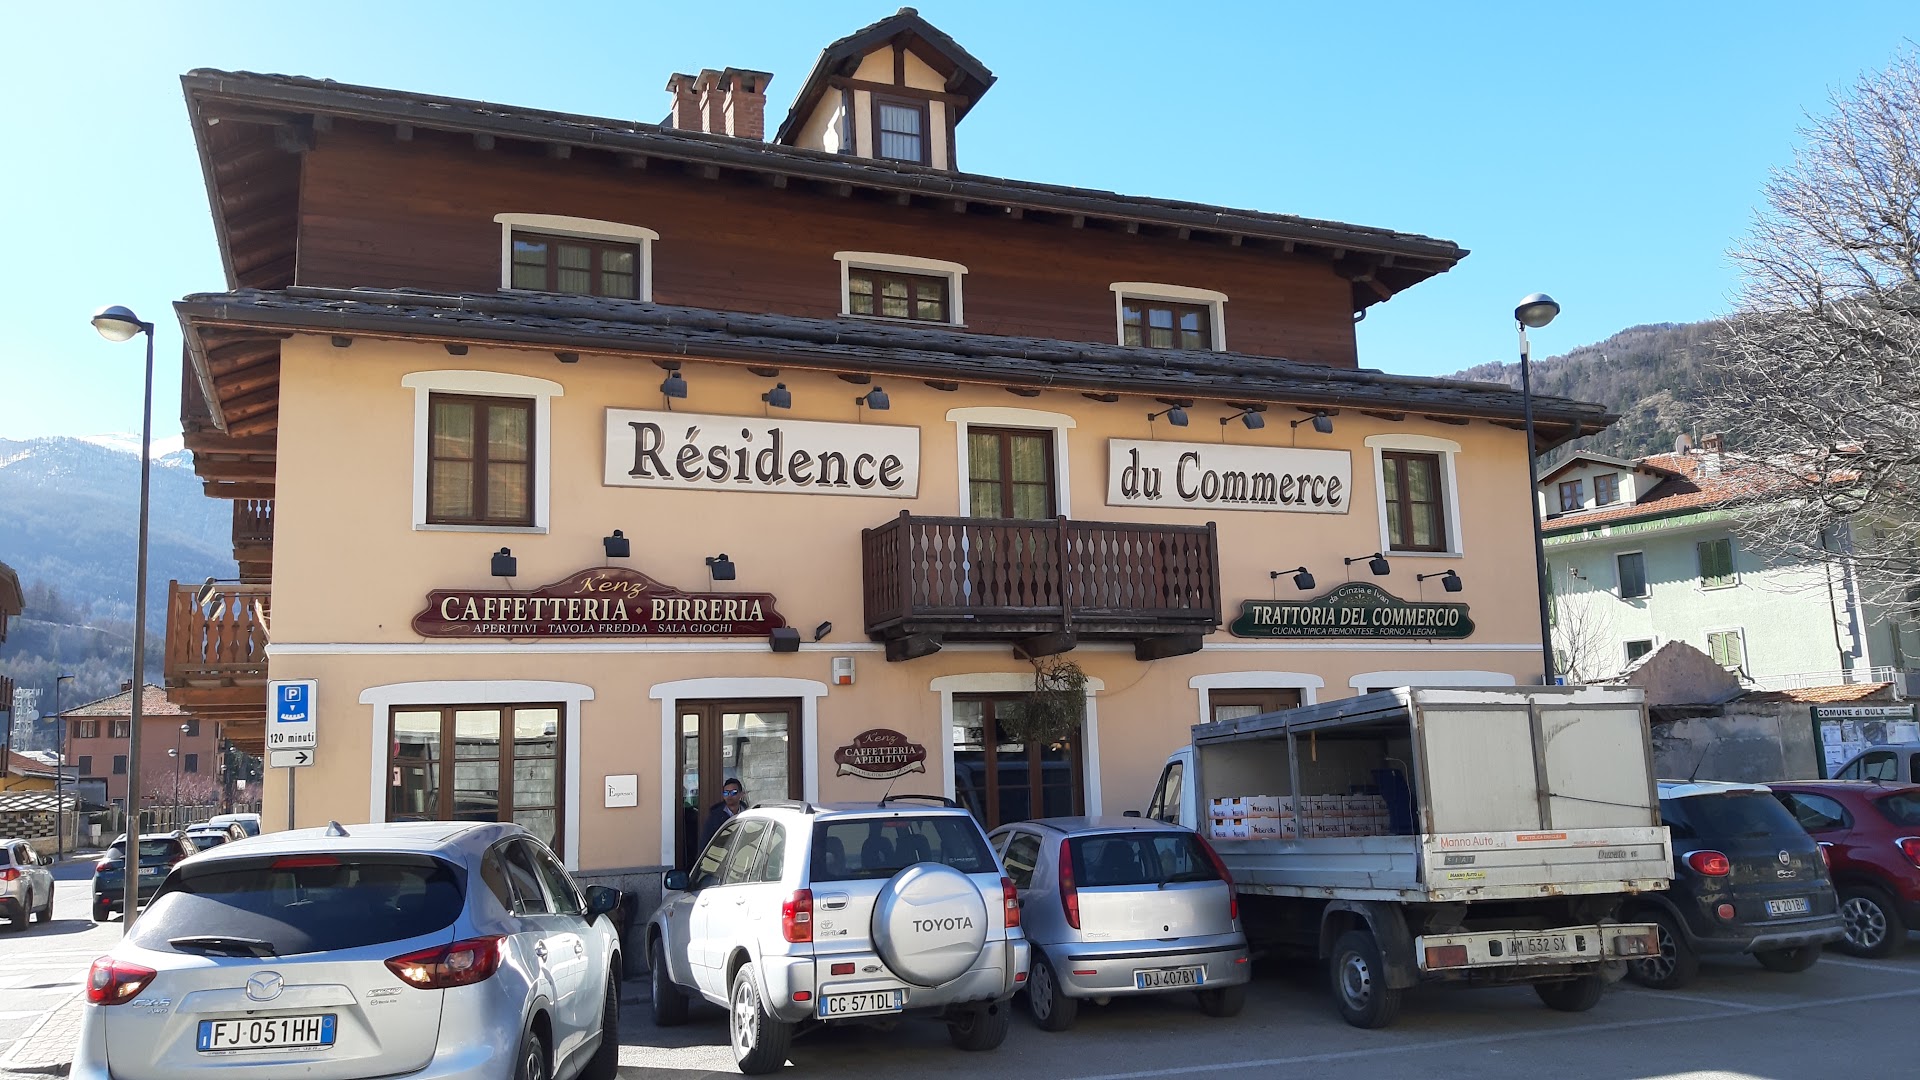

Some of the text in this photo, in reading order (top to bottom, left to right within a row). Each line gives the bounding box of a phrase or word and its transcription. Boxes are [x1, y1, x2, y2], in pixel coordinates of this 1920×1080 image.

[627, 421, 904, 490] Résidence
[1121, 447, 1343, 507] du Commerce
[1328, 595, 1339, 604] da
[1338, 586, 1365, 597] Cinzia
[1374, 589, 1390, 605] Ivan
[440, 596, 765, 622] CAFFETTERIA BIRRERIA
[1252, 606, 1459, 627] TRATTORIA DEL COMMERCIO
[472, 623, 732, 633] APERITIVI TAVOLA FREDDA SALA GIOCHI
[1271, 627, 1437, 636] CUCINA TIPICA PIEMONTESE FORNO A LEGNA
[1817, 708, 1852, 717] COMUNE
[1854, 708, 1863, 716] di
[1864, 708, 1886, 716] OULX
[270, 732, 314, 743] 120 minuti
[845, 745, 917, 757] CAFFETTERIA
[853, 754, 908, 765] APERITIVI
[1440, 836, 1471, 849] Manno
[1473, 836, 1494, 847] Auto
[912, 916, 973, 933] TOYOTA
[1528, 938, 1550, 952] 532
[1553, 936, 1567, 951] SX
[1143, 969, 1196, 987] DJ 407BY
[829, 992, 893, 1013] CG 571DL
[213, 1018, 320, 1046] FJ 051HH
